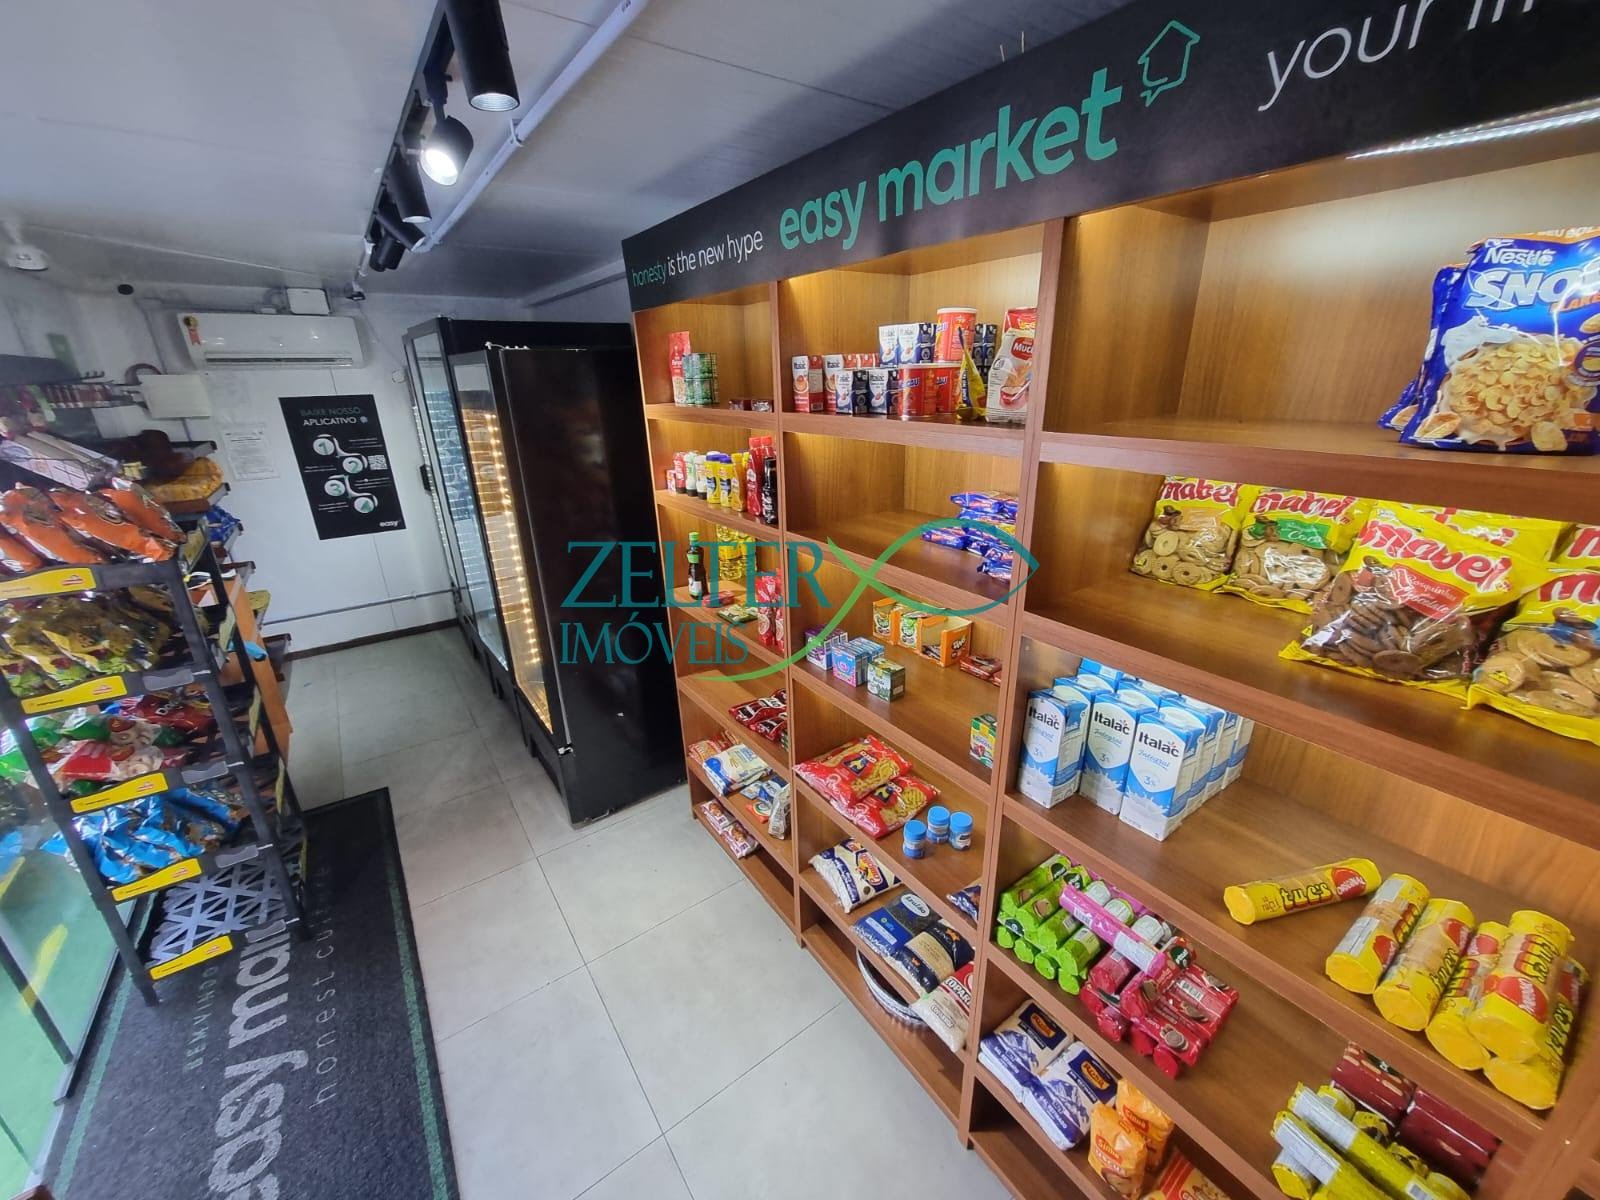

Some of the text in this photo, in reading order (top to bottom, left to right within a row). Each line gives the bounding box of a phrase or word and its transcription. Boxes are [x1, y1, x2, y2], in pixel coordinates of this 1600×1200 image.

[1258, 0, 1434, 112] your
[780, 68, 1122, 250] easy market
[632, 230, 764, 286] honesty is the new hype
[1483, 247, 1556, 267] Nestlé
[1013, 342, 1033, 353] Muc
[303, 416, 357, 426] APLICATIVO
[317, 441, 329, 455] 1
[347, 460, 358, 473] 2
[330, 483, 342, 496] 3
[1028, 706, 1060, 730] Italac
[1094, 711, 1130, 735] Italac
[1138, 731, 1180, 758] Italac
[228, 932, 290, 1049] mar
[309, 971, 338, 1110] honest
